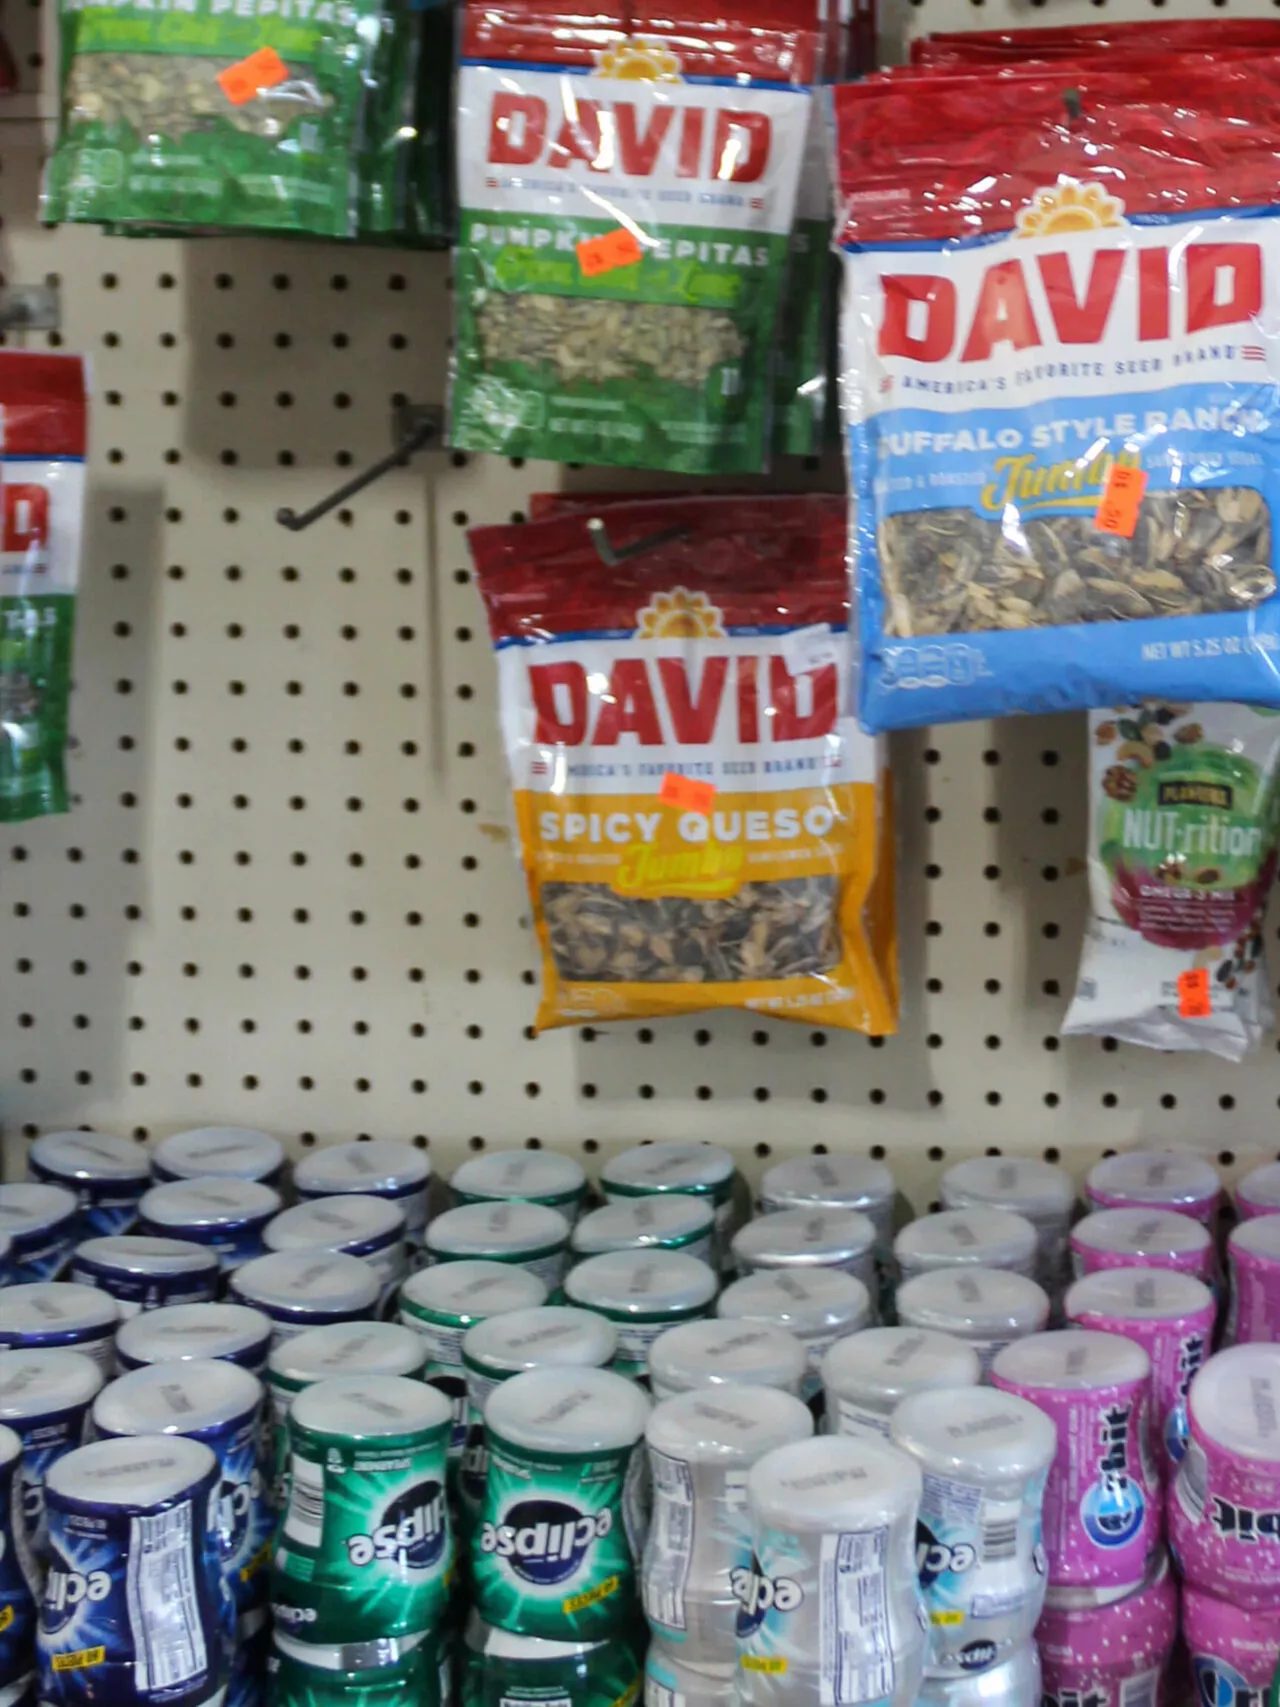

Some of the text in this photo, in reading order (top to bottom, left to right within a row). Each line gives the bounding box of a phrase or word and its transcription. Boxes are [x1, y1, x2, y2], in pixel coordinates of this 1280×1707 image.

[487, 91, 772, 184] DAVID
[470, 222, 601, 248] PUMPK
[877, 241, 1264, 364] DAVID
[901, 344, 1236, 395] AMERICA'S FAVORITE SEED BRAND
[1030, 412, 1138, 448] STYLE
[529, 654, 838, 747] DAVID
[540, 804, 834, 843] SPICY QUESO
[346, 1495, 447, 1567] lipse
[480, 1506, 614, 1563] eclipse
